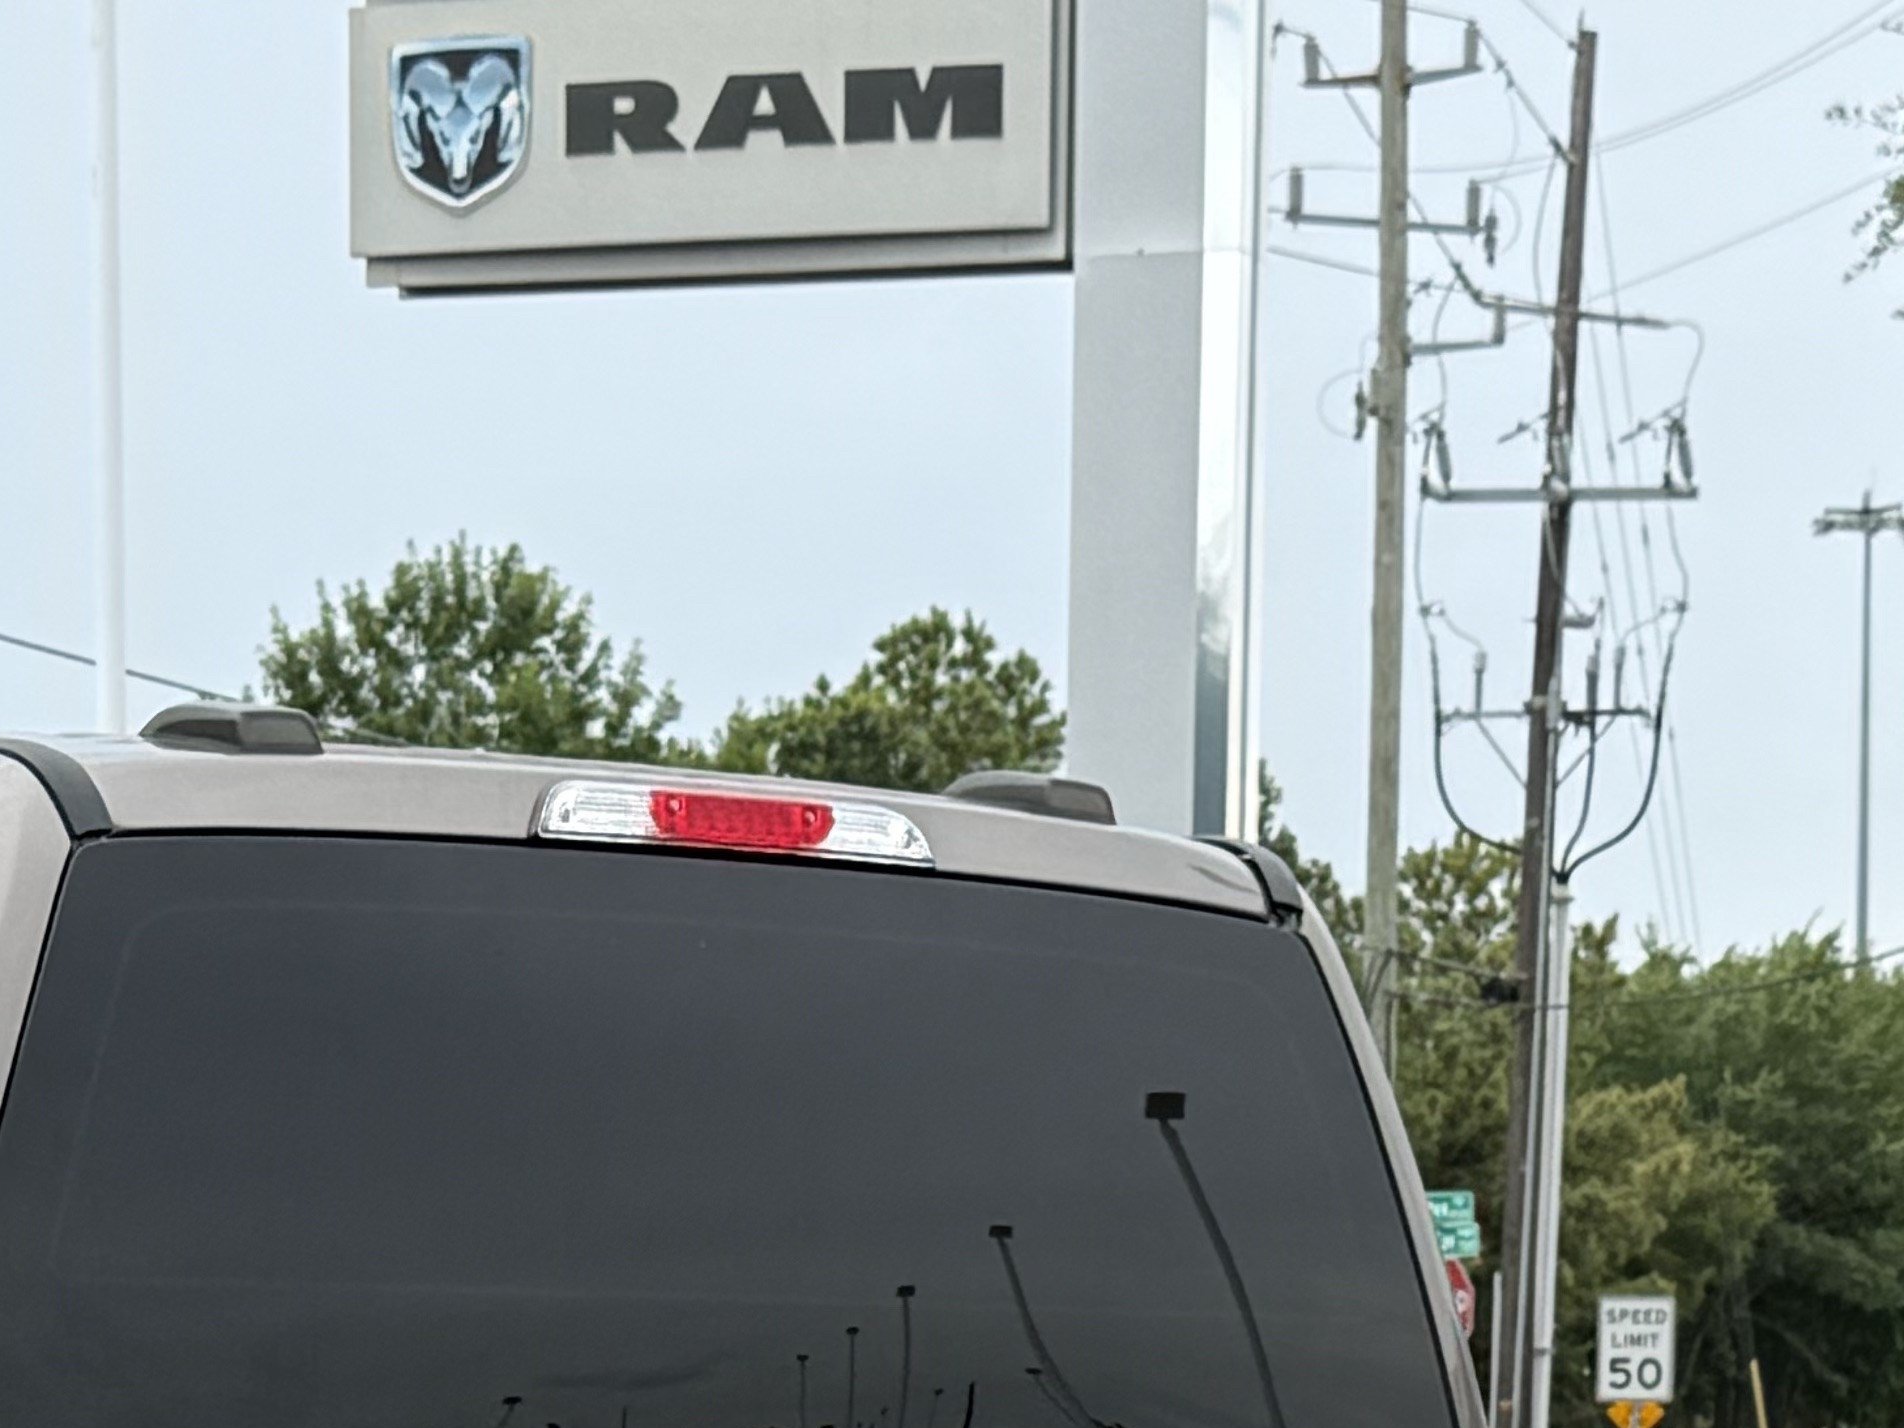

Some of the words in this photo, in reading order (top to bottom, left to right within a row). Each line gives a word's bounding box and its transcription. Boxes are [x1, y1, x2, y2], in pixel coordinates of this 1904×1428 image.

[565, 64, 1003, 157] RAM
[1607, 1307, 1667, 1325] SPEED
[1611, 1332, 1659, 1349] LIMIT
[1609, 1357, 1662, 1390] 50
